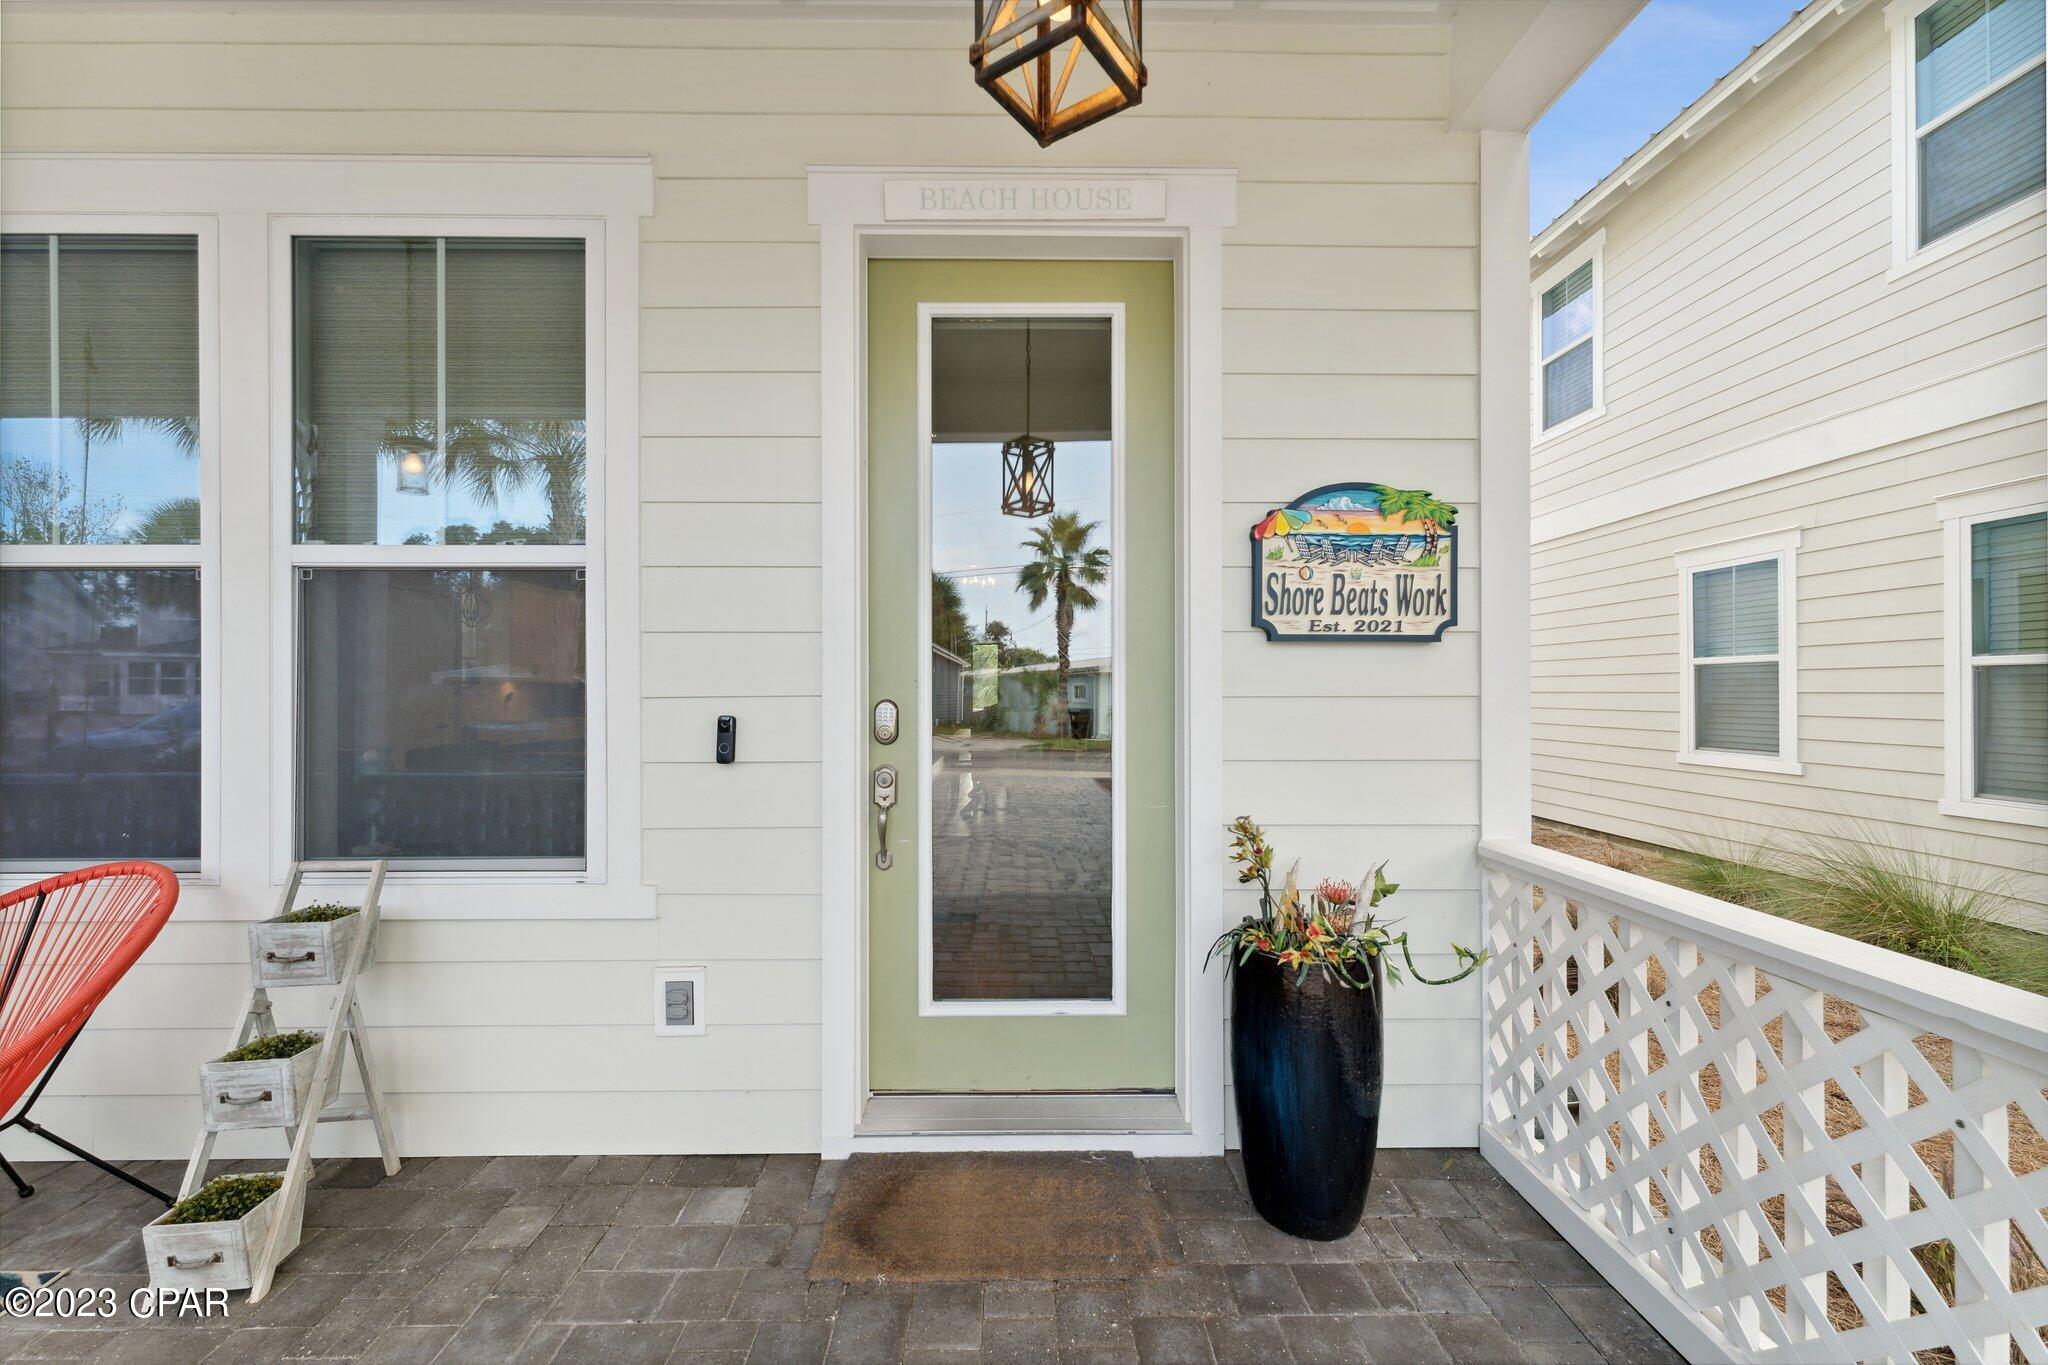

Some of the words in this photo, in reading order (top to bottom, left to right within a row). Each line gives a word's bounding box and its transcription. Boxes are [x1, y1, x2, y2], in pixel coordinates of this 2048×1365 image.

[918, 187, 1017, 211] BEACH
[1030, 187, 1132, 211] HOUSE
[1264, 572, 1325, 616] Shore
[1330, 573, 1389, 616] Beats
[1396, 573, 1447, 617] Work
[1308, 619, 1346, 633] Est.
[1353, 619, 1404, 633] 2021
